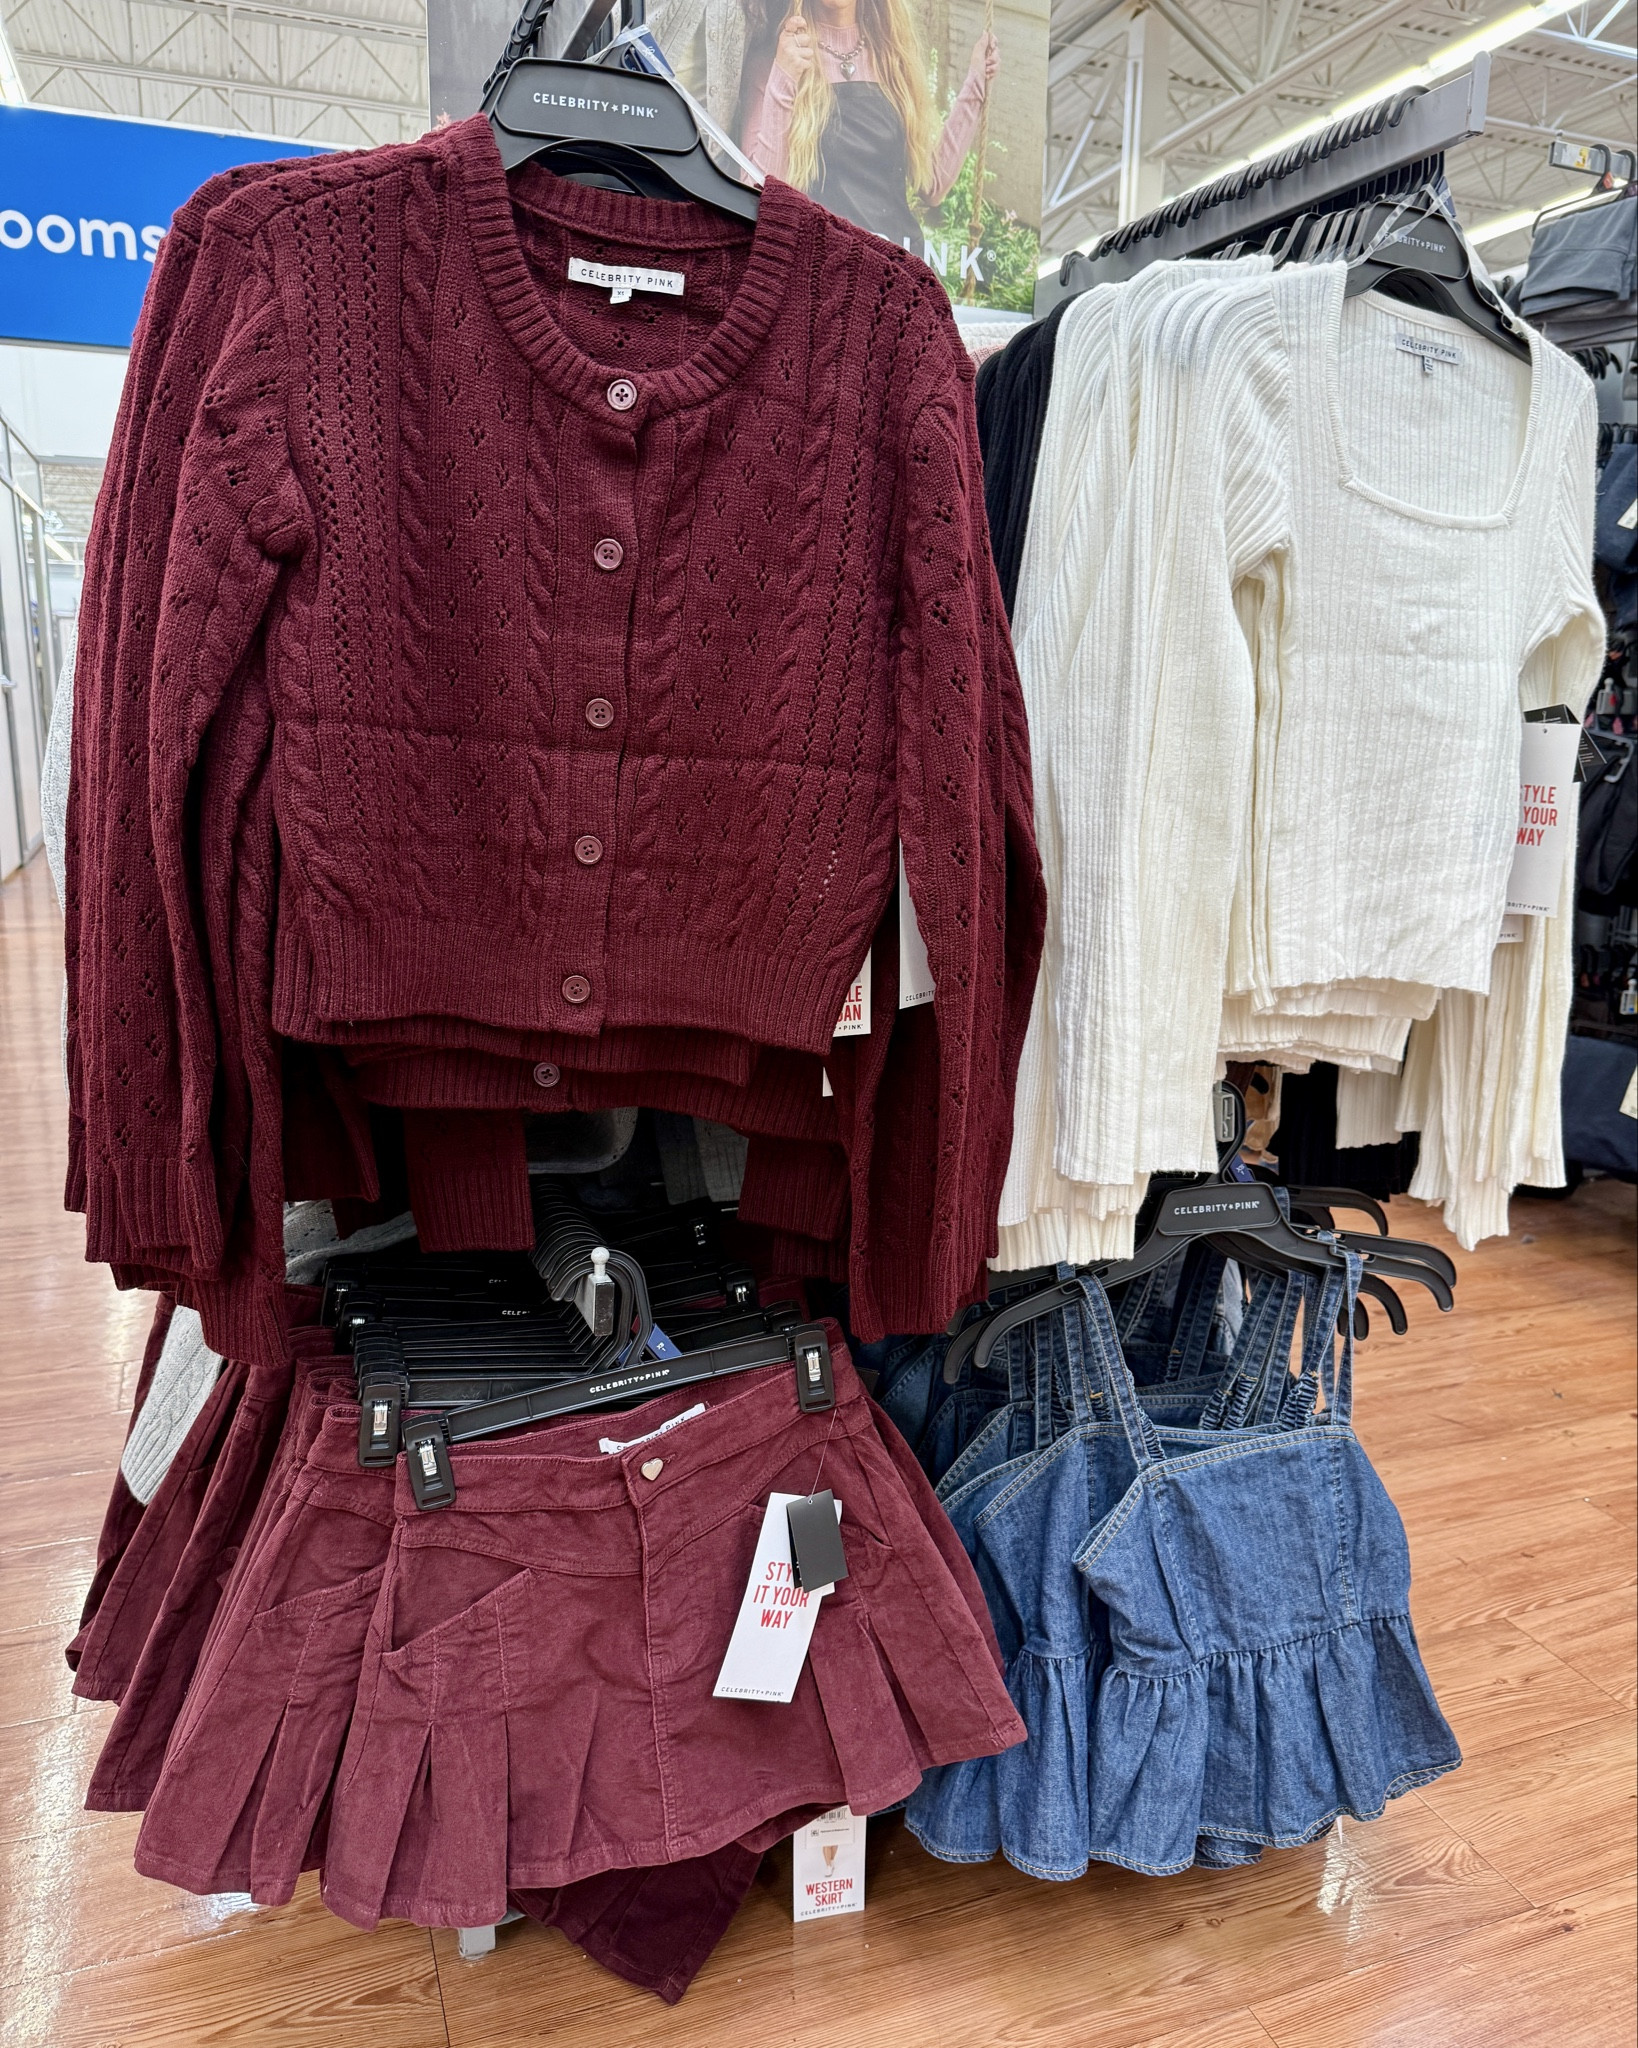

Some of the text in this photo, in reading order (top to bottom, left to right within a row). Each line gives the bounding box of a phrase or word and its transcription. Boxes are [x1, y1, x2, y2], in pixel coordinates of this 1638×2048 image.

[533, 92, 655, 119] CELEBRITY PINK
[581, 268, 673, 288] CELEBRITY PINK
[1401, 339, 1457, 359] CELEBRITY PINK
[1520, 784, 1557, 804] TYLE
[1523, 805, 1558, 826] YOUR
[1516, 827, 1545, 846] WAY
[1174, 1201, 1259, 1216] CELEBRITY PINK
[589, 1369, 670, 1394] CELEBRITY PINK
[765, 1561, 793, 1582] STY
[753, 1585, 810, 1608] IT YOUR
[761, 1608, 794, 1629] WAY
[721, 1686, 760, 1695] CELEBRITY
[805, 1877, 854, 1896] WESTERN
[815, 1891, 844, 1907] SKIRT
